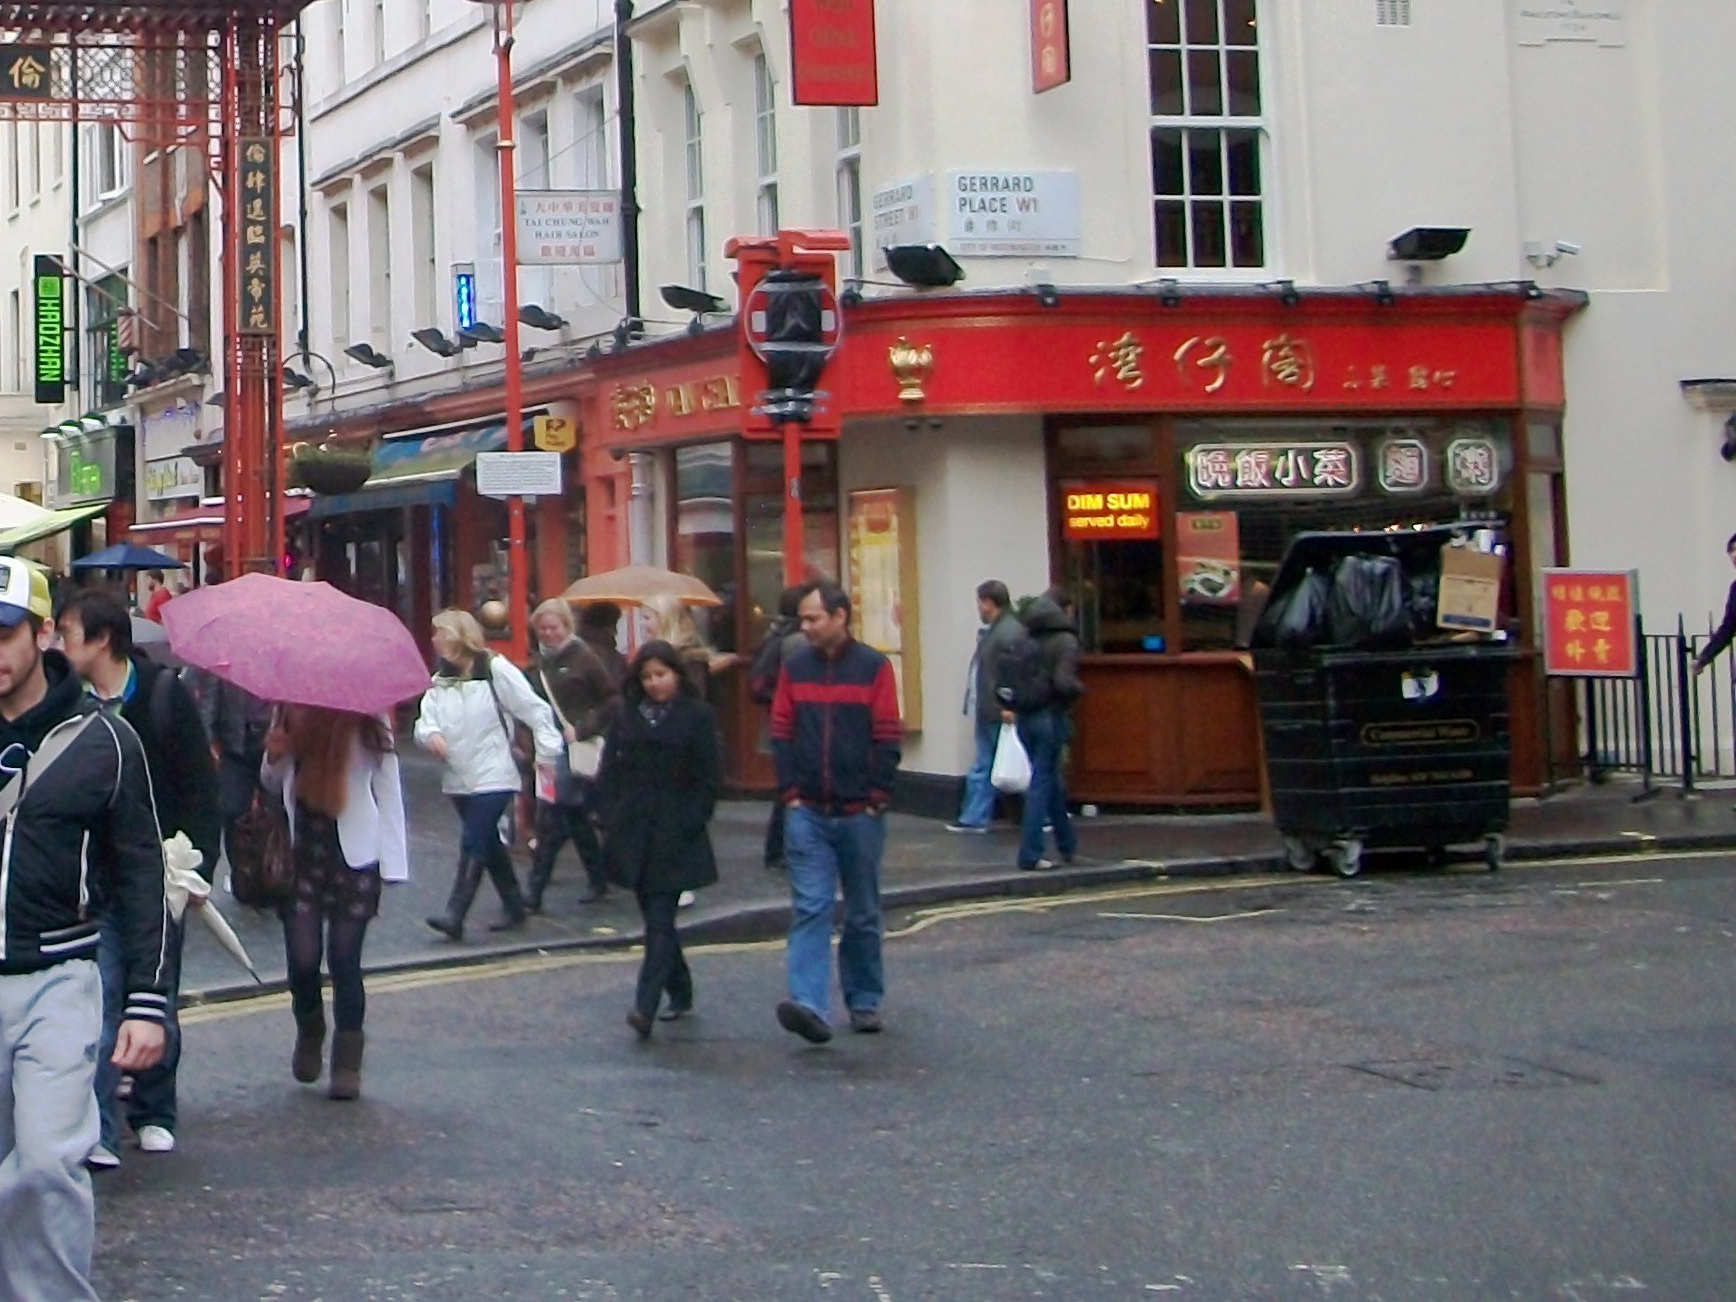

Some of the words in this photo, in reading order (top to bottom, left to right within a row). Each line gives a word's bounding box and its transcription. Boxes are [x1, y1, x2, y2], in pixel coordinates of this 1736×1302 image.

[958, 176, 1035, 193] GERRARD
[873, 185, 914, 209] GERRARD
[958, 197, 1008, 214] PLACE
[1016, 197, 1040, 214] W1
[525, 218, 541, 227] TAI
[545, 218, 583, 227] CHUNG
[874, 209, 905, 230] STREET
[535, 230, 563, 239] HAIR
[566, 230, 600, 239] SALON
[38, 299, 62, 383] HAOZHAN
[1198, 450, 1350, 488] 晚飯小菜
[1068, 494, 1103, 510] DIM
[1107, 493, 1150, 510] SUM
[1069, 515, 1114, 528] served
[1117, 513, 1150, 529] daily
